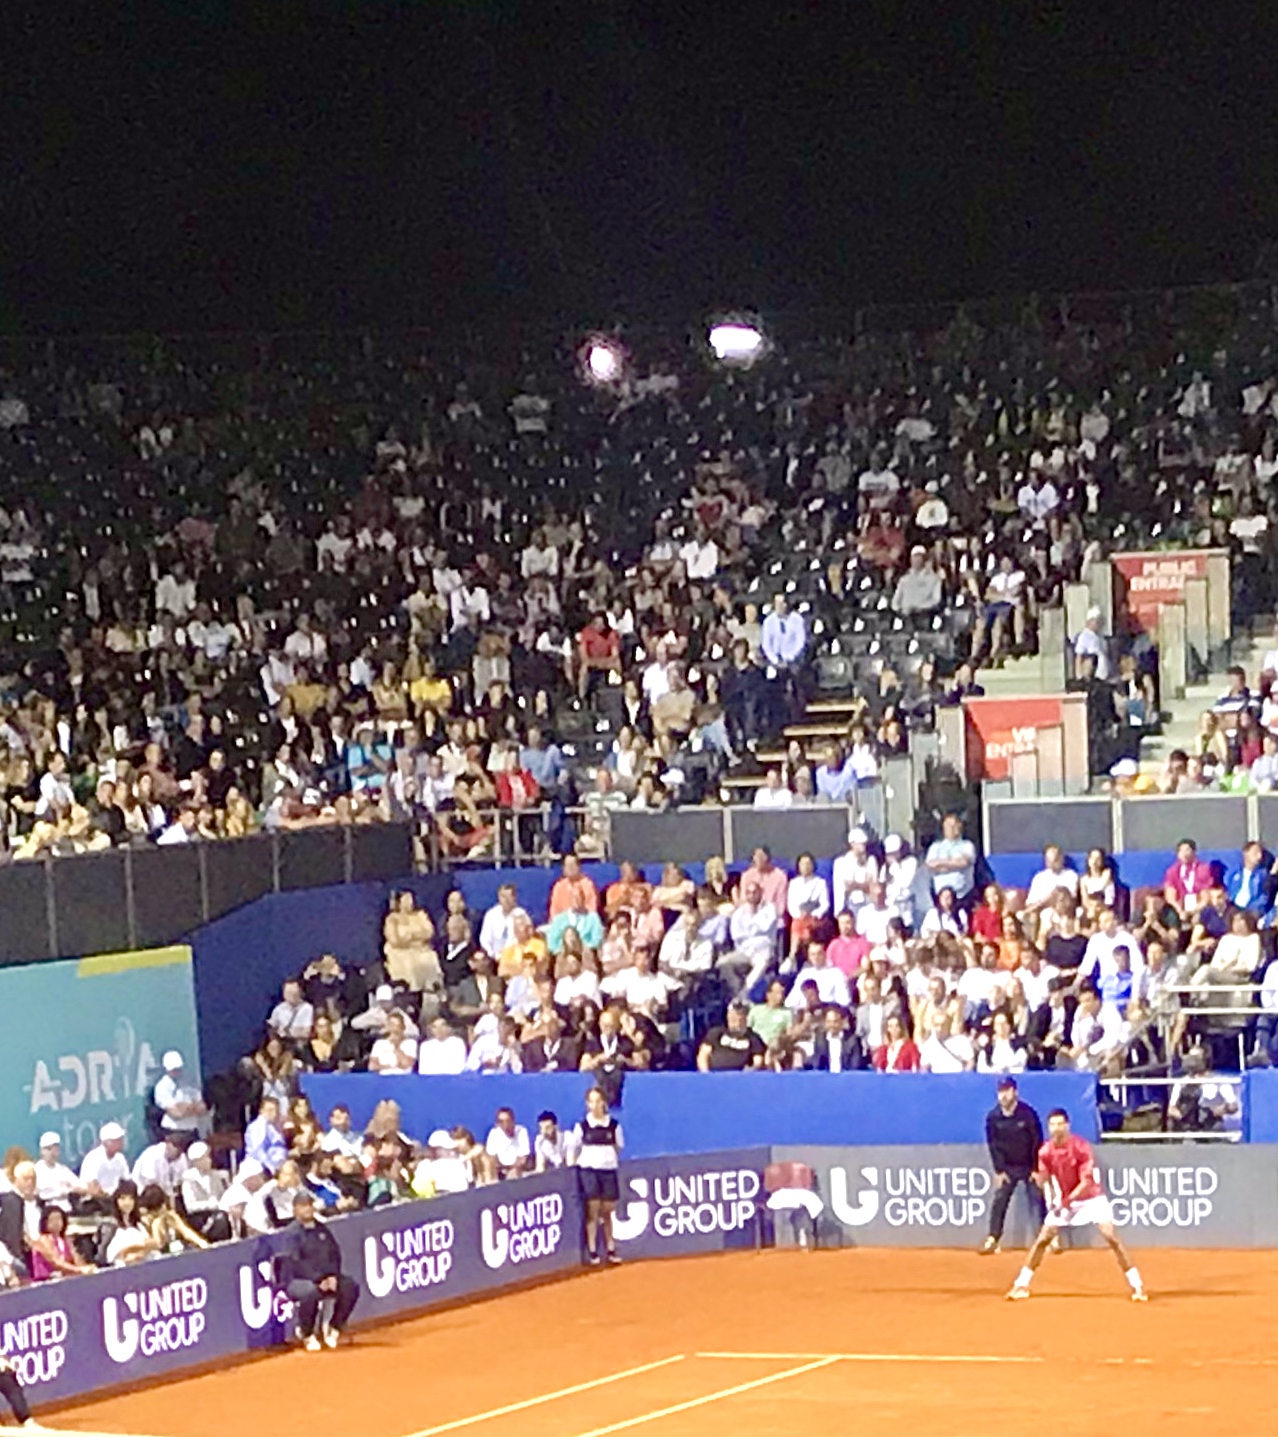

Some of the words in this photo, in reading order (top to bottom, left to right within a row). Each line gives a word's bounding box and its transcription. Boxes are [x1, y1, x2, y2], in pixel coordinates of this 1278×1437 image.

[654, 1169, 761, 1207] UNITED
[884, 1166, 991, 1197] UNITED
[1108, 1166, 1219, 1196] UNITED
[509, 1193, 563, 1229] UNITED
[653, 1201, 757, 1237] GROUP
[883, 1195, 986, 1227] GROUP
[1108, 1197, 1214, 1227] GROUP
[395, 1219, 454, 1257] UNITED
[508, 1225, 561, 1263] GROUP
[395, 1253, 453, 1292] GROUP
[138, 1277, 208, 1322] UNITED
[140, 1311, 206, 1357] GROUP
[10, 1345, 65, 1387] ROUP
